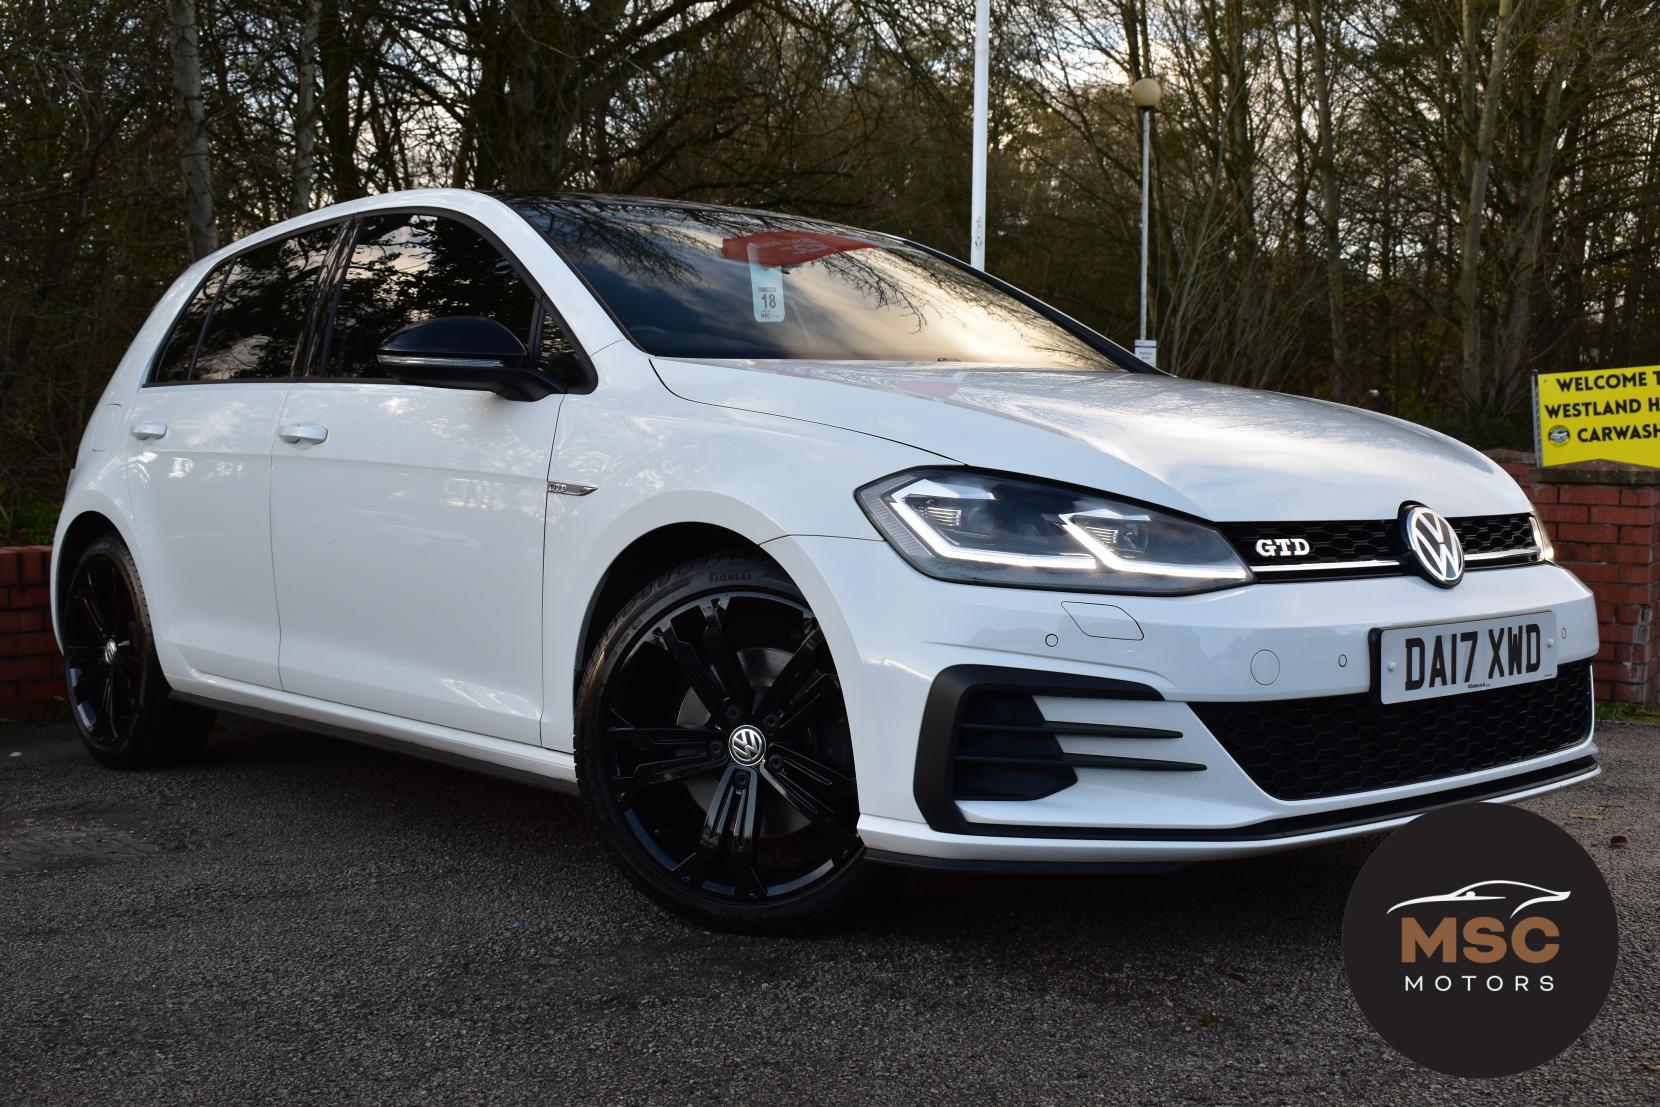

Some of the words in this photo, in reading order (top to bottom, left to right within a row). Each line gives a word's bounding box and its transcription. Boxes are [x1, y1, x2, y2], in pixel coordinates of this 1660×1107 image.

[761, 293, 776, 309] 18
[1556, 372, 1647, 392] WELCOME
[1544, 399, 1642, 419] WESTLAND
[1577, 423, 1660, 442] CARWASH
[1255, 538, 1310, 557] GTD
[1405, 631, 1478, 691] DA17
[1488, 623, 1541, 679] XWD
